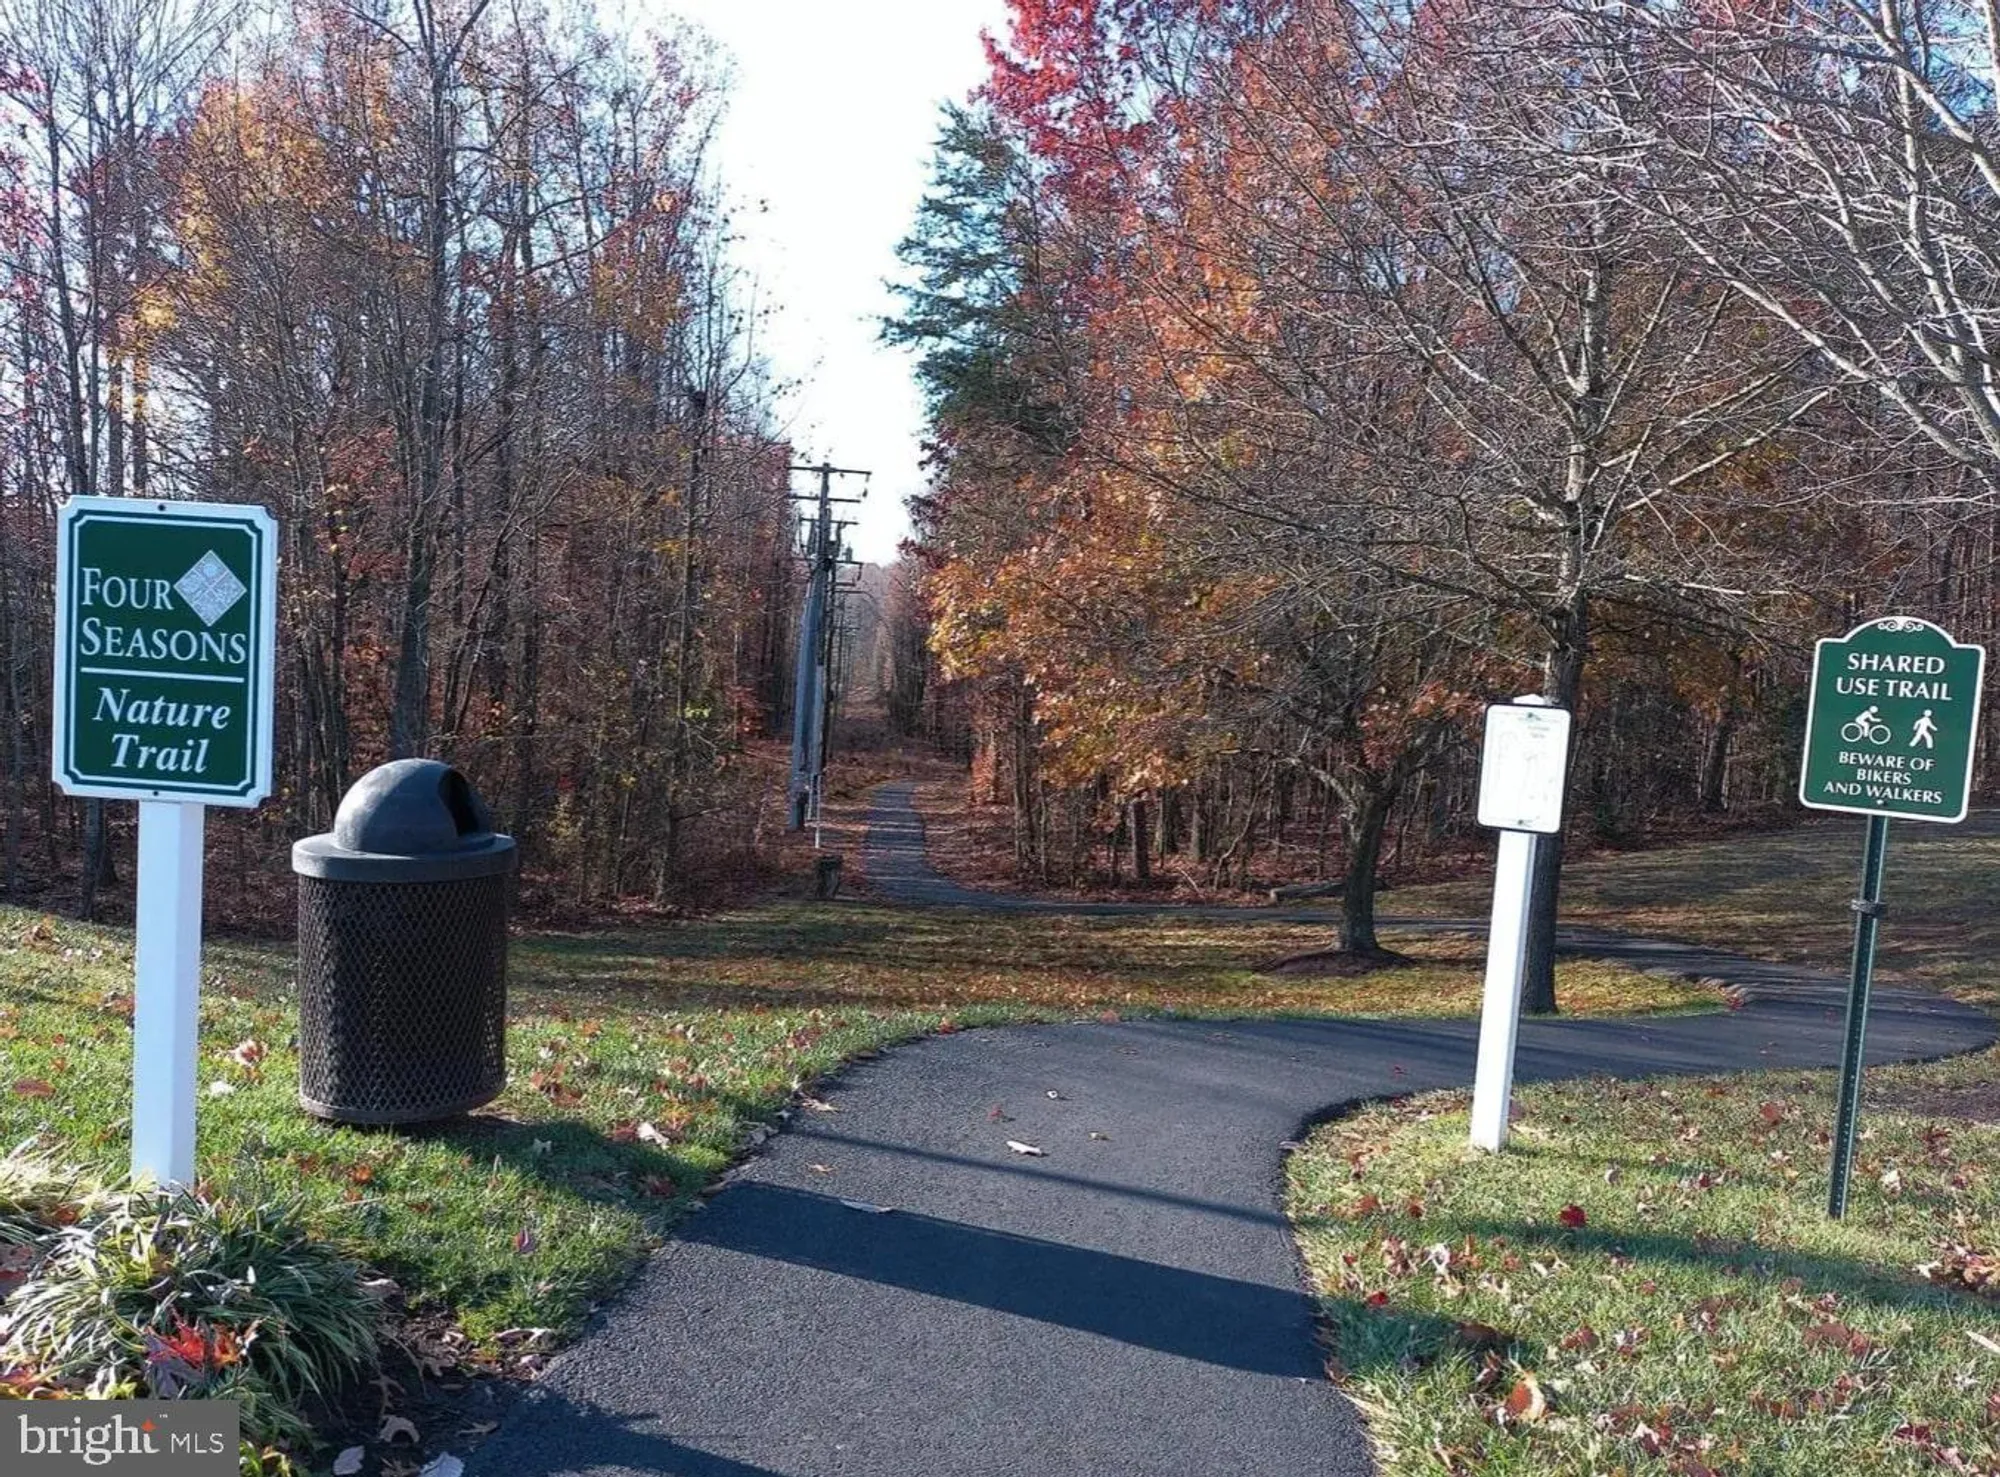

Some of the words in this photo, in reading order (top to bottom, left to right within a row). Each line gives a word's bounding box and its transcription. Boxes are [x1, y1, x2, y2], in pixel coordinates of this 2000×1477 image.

[82, 567, 174, 611] FOUR
[80, 617, 247, 664] SEASONS
[1847, 653, 1945, 675] SHARED
[1836, 677, 1879, 696] USE
[1884, 680, 1953, 701] TRAIL
[93, 688, 231, 730] Nature
[110, 734, 210, 774] Trail
[1839, 751, 1905, 769] BEWARE
[1909, 758, 1935, 771] OF
[1856, 769, 1912, 785] BIKERS
[1823, 781, 1862, 796] AND
[1866, 785, 1943, 805] WALKERS
